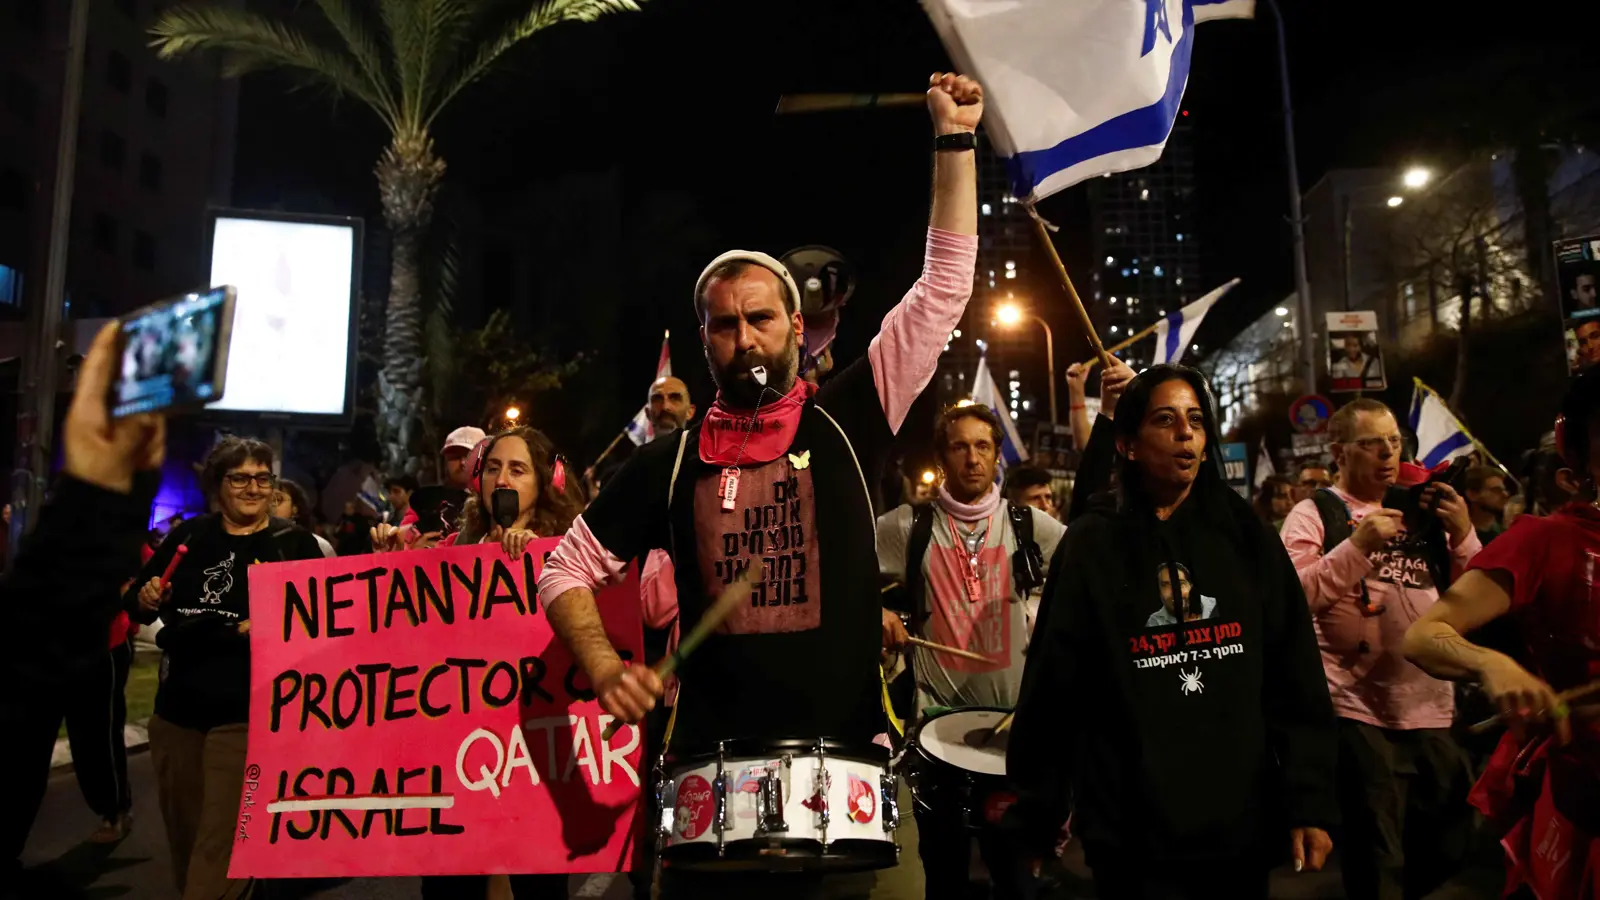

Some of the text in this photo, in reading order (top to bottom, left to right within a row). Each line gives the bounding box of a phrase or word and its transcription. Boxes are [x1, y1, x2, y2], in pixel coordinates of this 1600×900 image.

[772, 476, 799, 501] אם
[744, 501, 801, 530] אנחנו
[722, 524, 804, 557] מנצחים
[761, 551, 807, 581] למה
[1379, 566, 1421, 585] DEAL
[283, 551, 551, 643] NETANYAH
[751, 578, 808, 608] בוכה
[1213, 622, 1242, 645] מתן
[1133, 651, 1188, 668] לאוקטובר
[1213, 643, 1244, 659] נחטף
[270, 656, 554, 732] PROTECTOR
[456, 713, 641, 798] QATAR
[267, 765, 465, 844] ISRAEL
